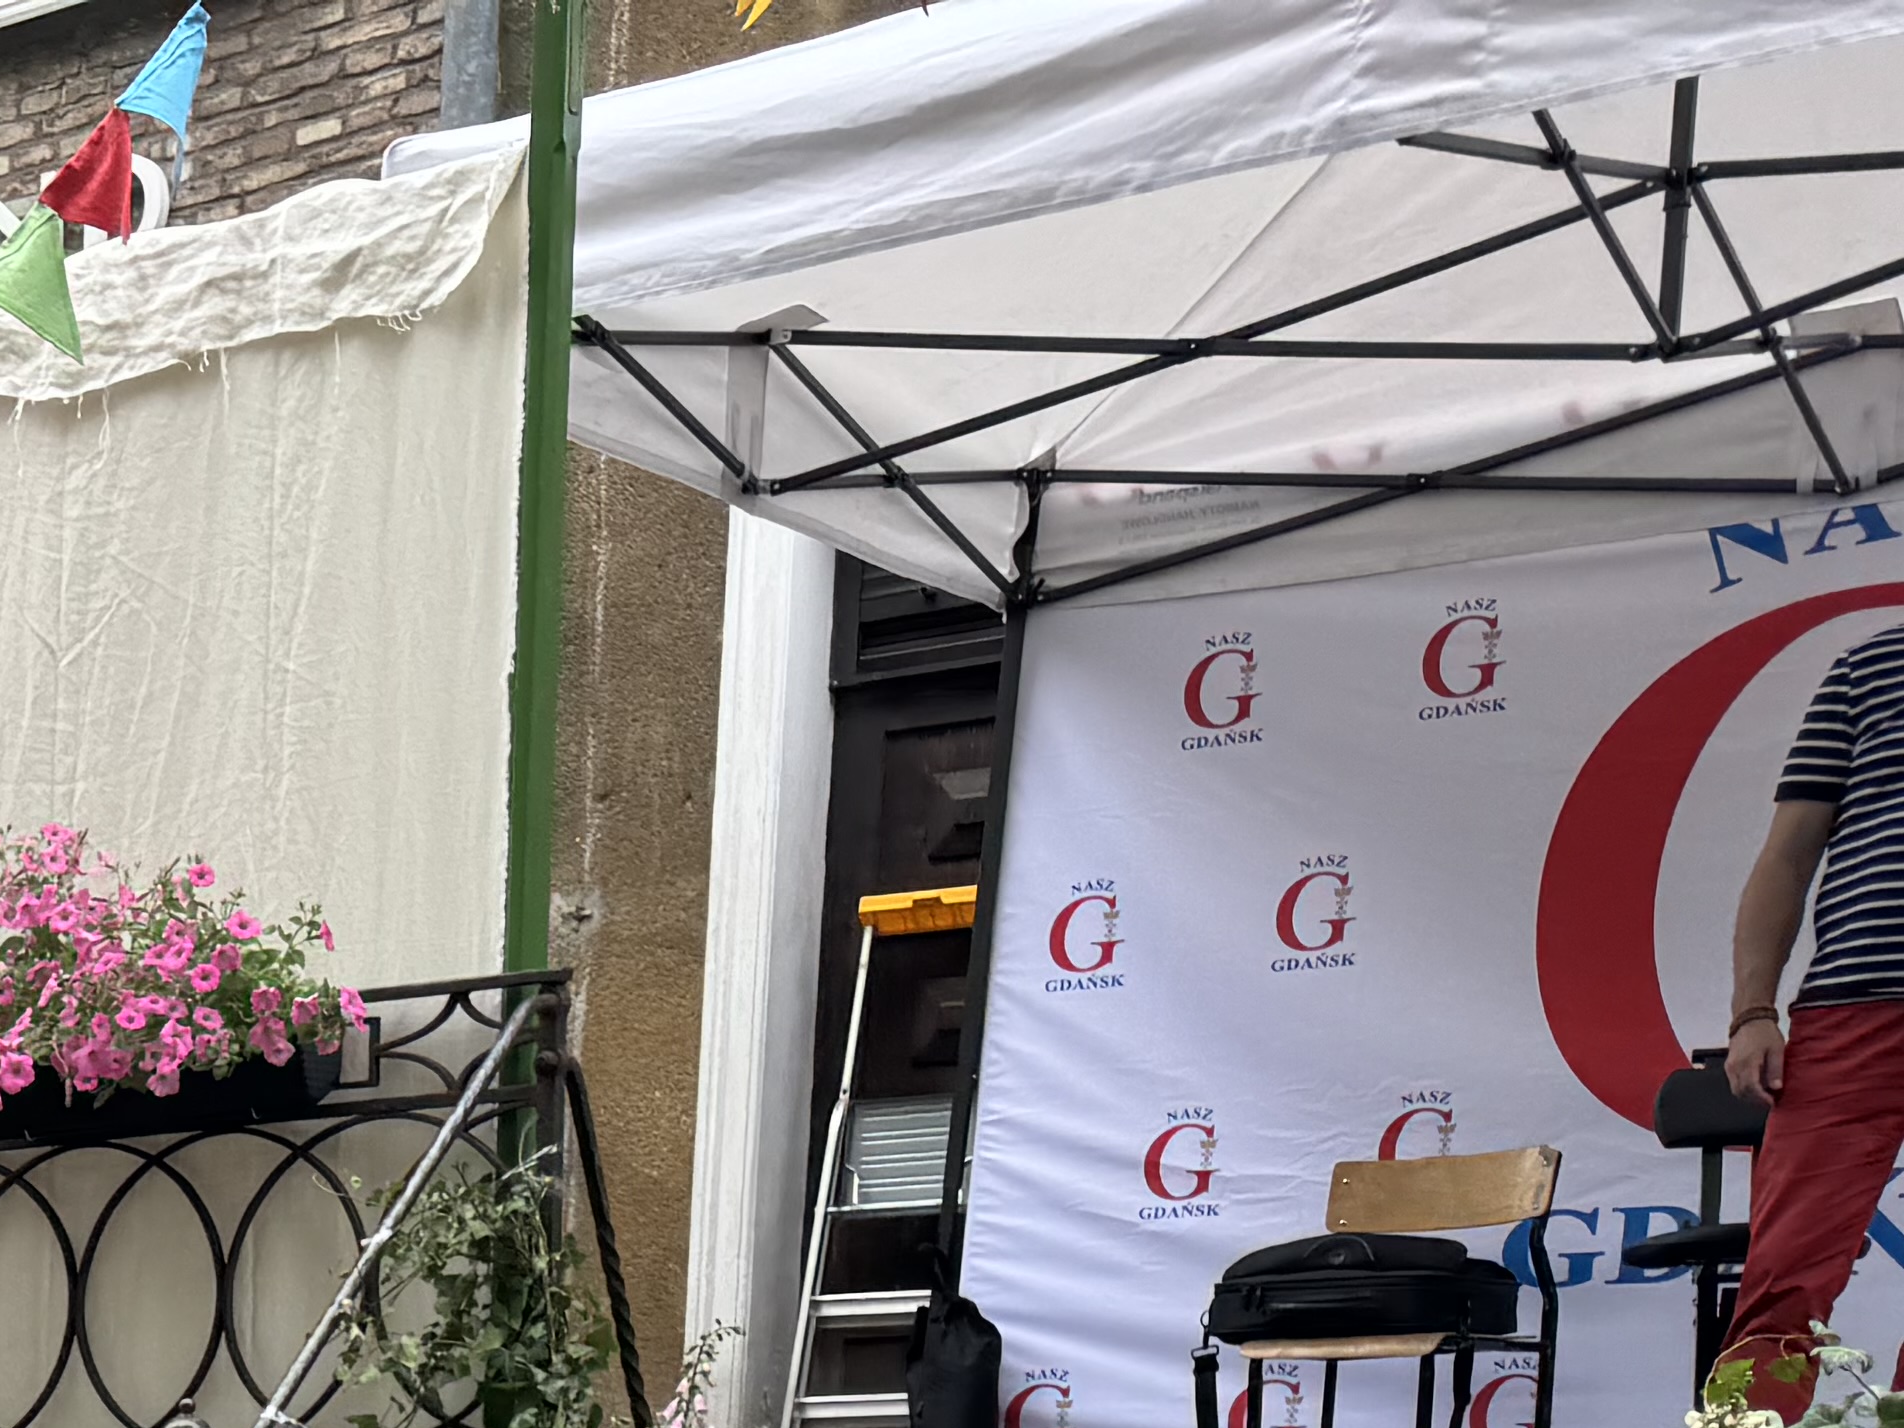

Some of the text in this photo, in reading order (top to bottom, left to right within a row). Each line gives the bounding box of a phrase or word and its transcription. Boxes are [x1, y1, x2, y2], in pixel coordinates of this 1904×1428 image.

[1445, 597, 1497, 618] NASZ
[1205, 631, 1254, 652] NASZ
[1418, 697, 1507, 721] GDAŃSK
[1181, 728, 1264, 751] GDAŃSK
[1299, 853, 1349, 872] NASZ
[1071, 877, 1116, 896] NASZ
[1270, 951, 1357, 973] GDAŃSK
[1044, 972, 1125, 993] GDAŃSK
[1400, 1089, 1453, 1109] NASZ
[1166, 1105, 1214, 1124] NASZ
[1139, 1201, 1220, 1221] GDAŃSK
[1024, 1367, 1070, 1383] NASZ
[1264, 1362, 1299, 1378] ASZ
[1493, 1357, 1537, 1374] NAS
